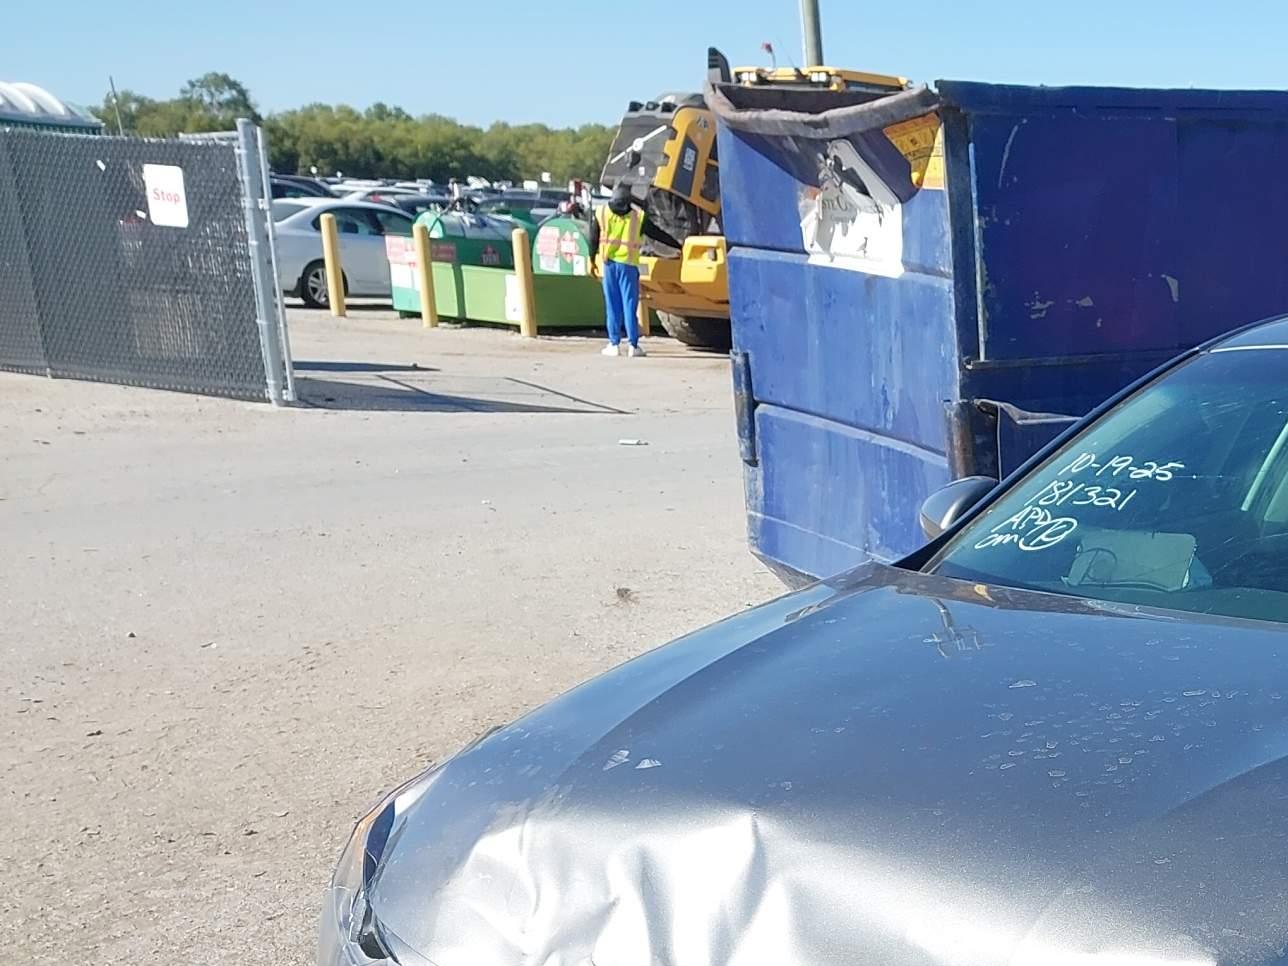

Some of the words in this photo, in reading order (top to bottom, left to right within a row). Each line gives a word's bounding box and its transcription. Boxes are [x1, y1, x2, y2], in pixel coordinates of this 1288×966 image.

[152, 187, 181, 205] Stop
[1057, 453, 1185, 481] 10-19-25
[1024, 479, 1136, 511] 181321
